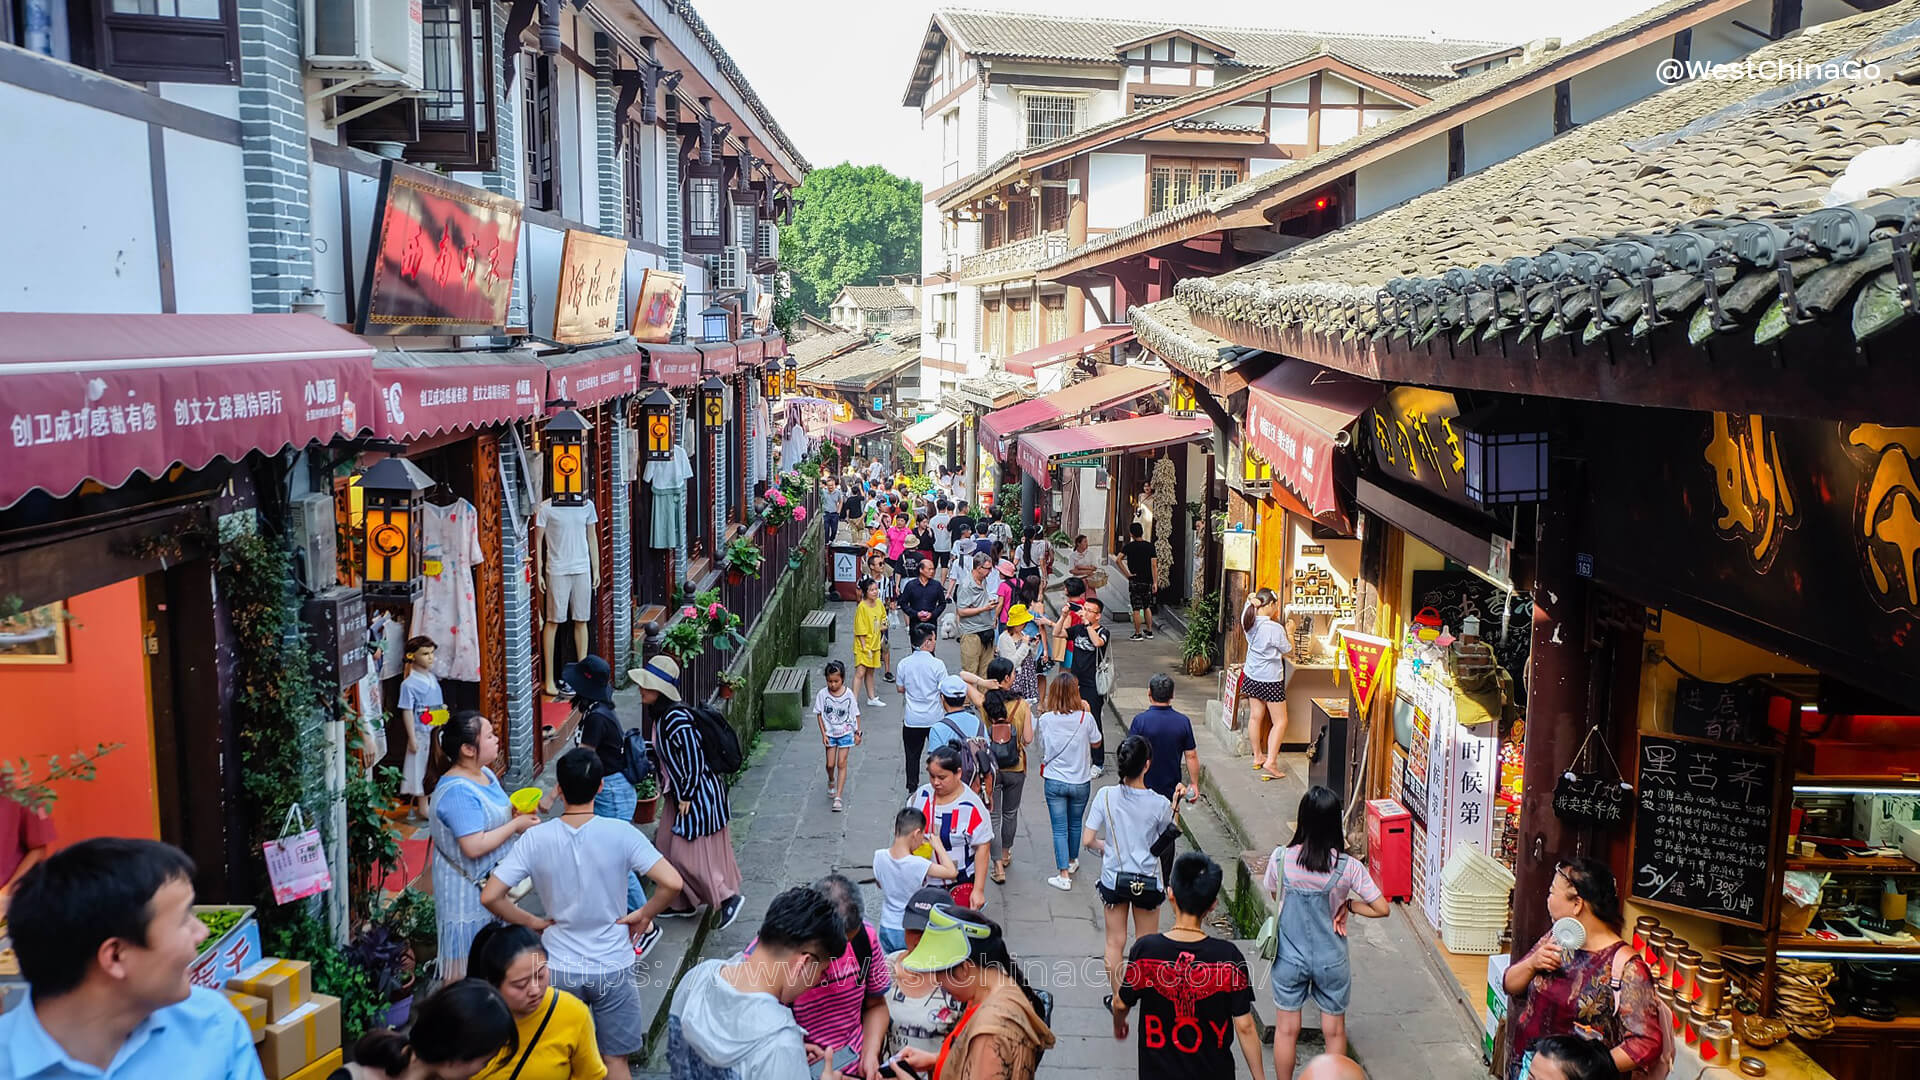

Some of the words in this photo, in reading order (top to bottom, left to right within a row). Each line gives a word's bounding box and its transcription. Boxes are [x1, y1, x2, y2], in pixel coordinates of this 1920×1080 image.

[10, 402, 157, 448] 创卫成功感谢有您
[173, 389, 283, 427] 创文之路期待同行
[1641, 745, 1767, 804] 黑苦荞
[1145, 1014, 1229, 1054] BOY
